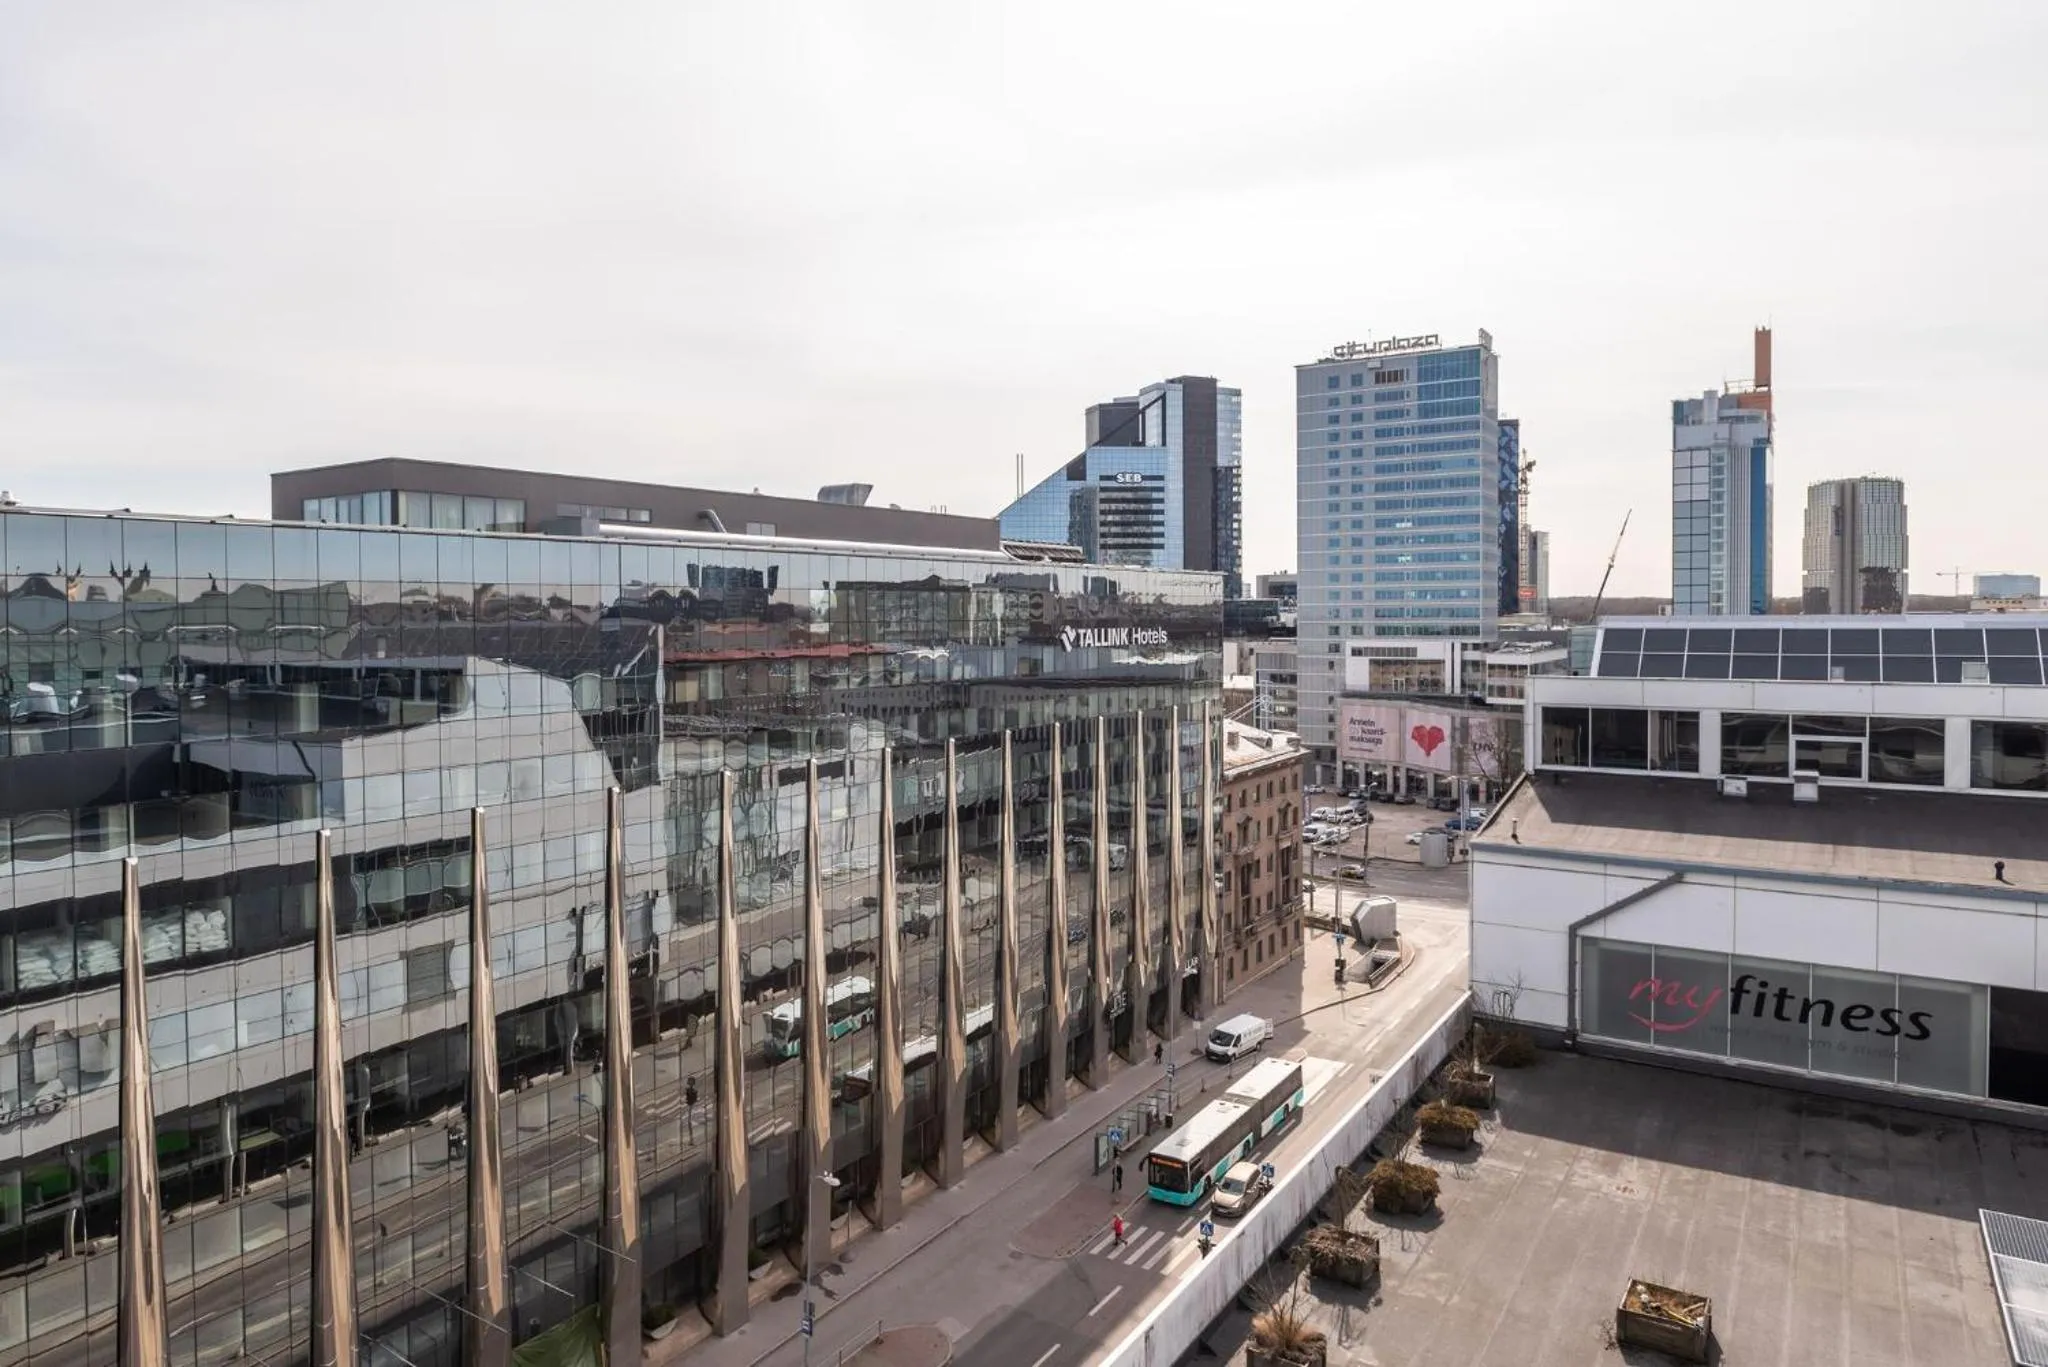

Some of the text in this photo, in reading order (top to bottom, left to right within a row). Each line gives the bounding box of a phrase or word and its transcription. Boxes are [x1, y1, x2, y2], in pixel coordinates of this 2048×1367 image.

[1333, 333, 1439, 358] cityplaza
[1116, 473, 1142, 483] SEB
[1078, 626, 1168, 648] TALLINK Hotels
